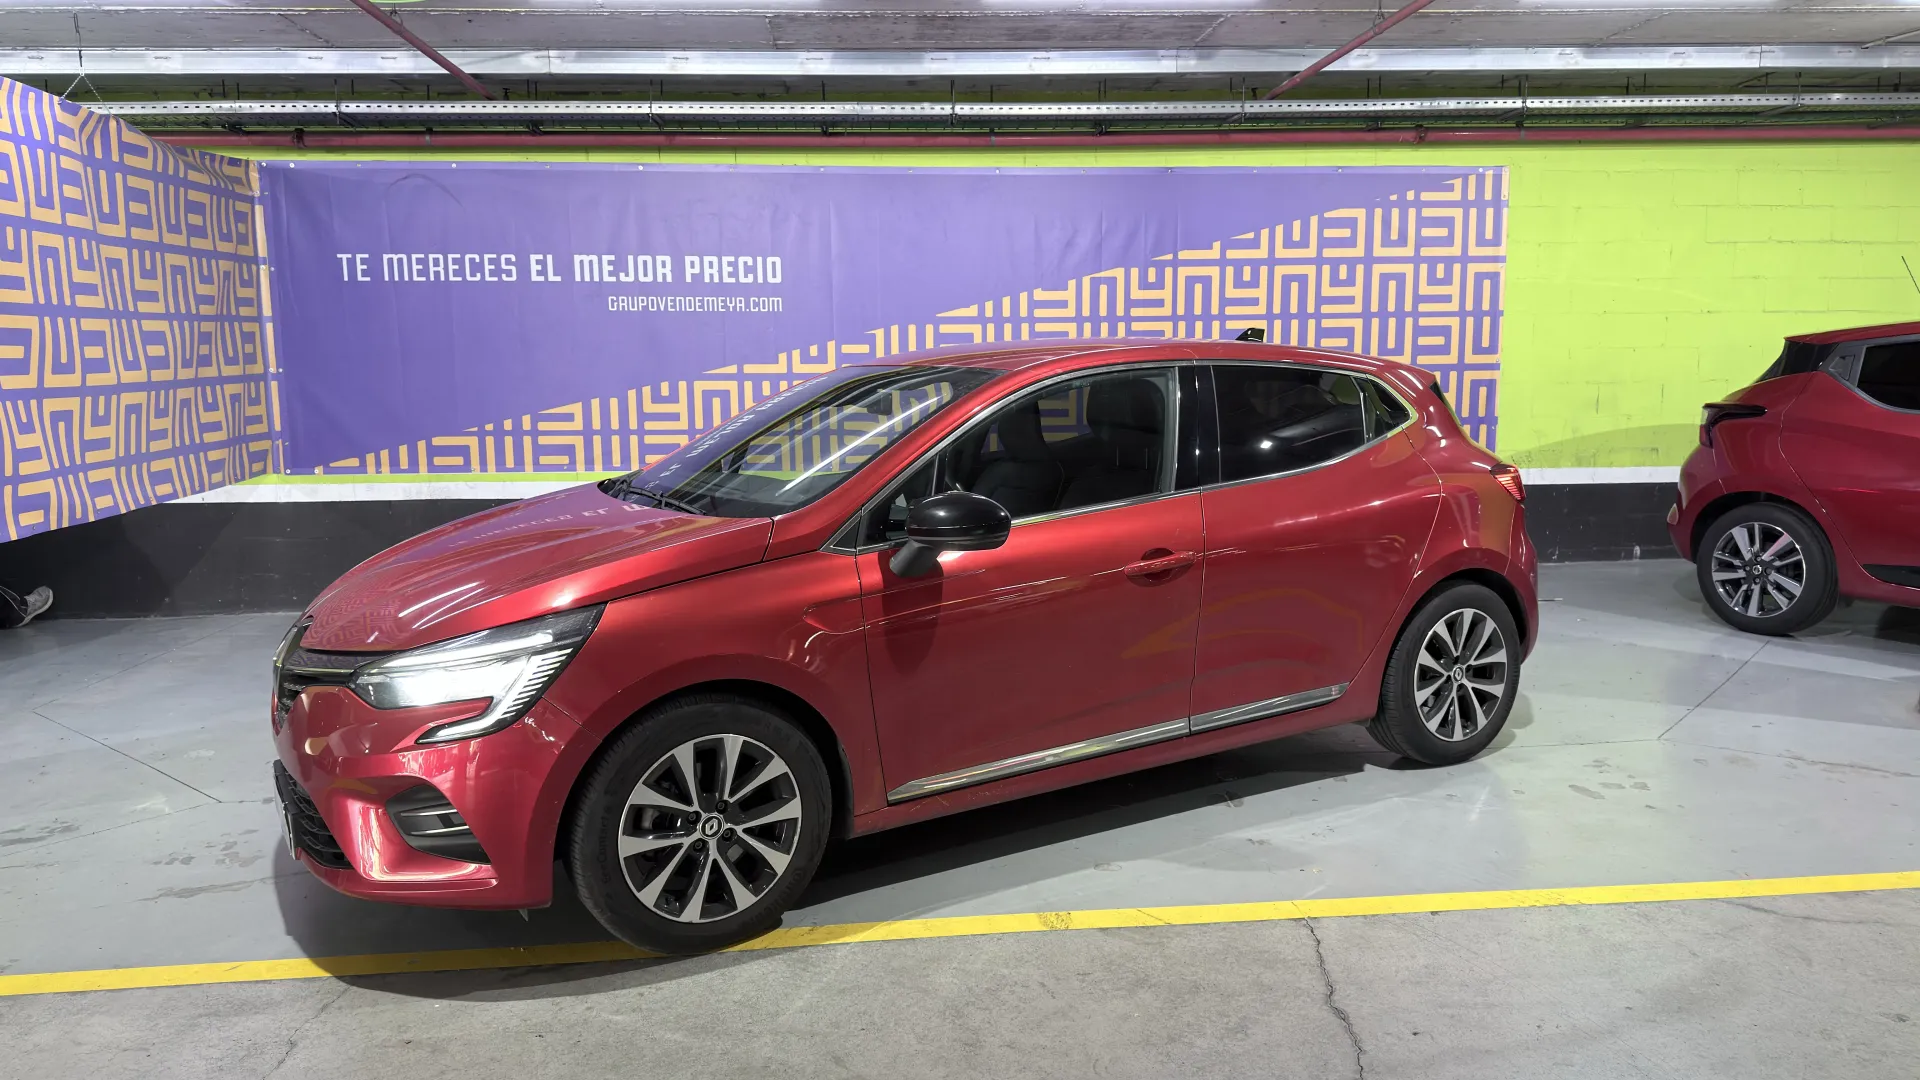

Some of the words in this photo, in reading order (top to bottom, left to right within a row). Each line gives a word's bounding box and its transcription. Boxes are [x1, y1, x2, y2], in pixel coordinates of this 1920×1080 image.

[336, 253, 371, 282] TE
[382, 253, 517, 282] MERECES
[529, 254, 562, 282] EL
[573, 254, 673, 283] MEJOR
[684, 255, 782, 284] PRECIO
[608, 296, 783, 312] GRUPOVENDEMEYA.COM
